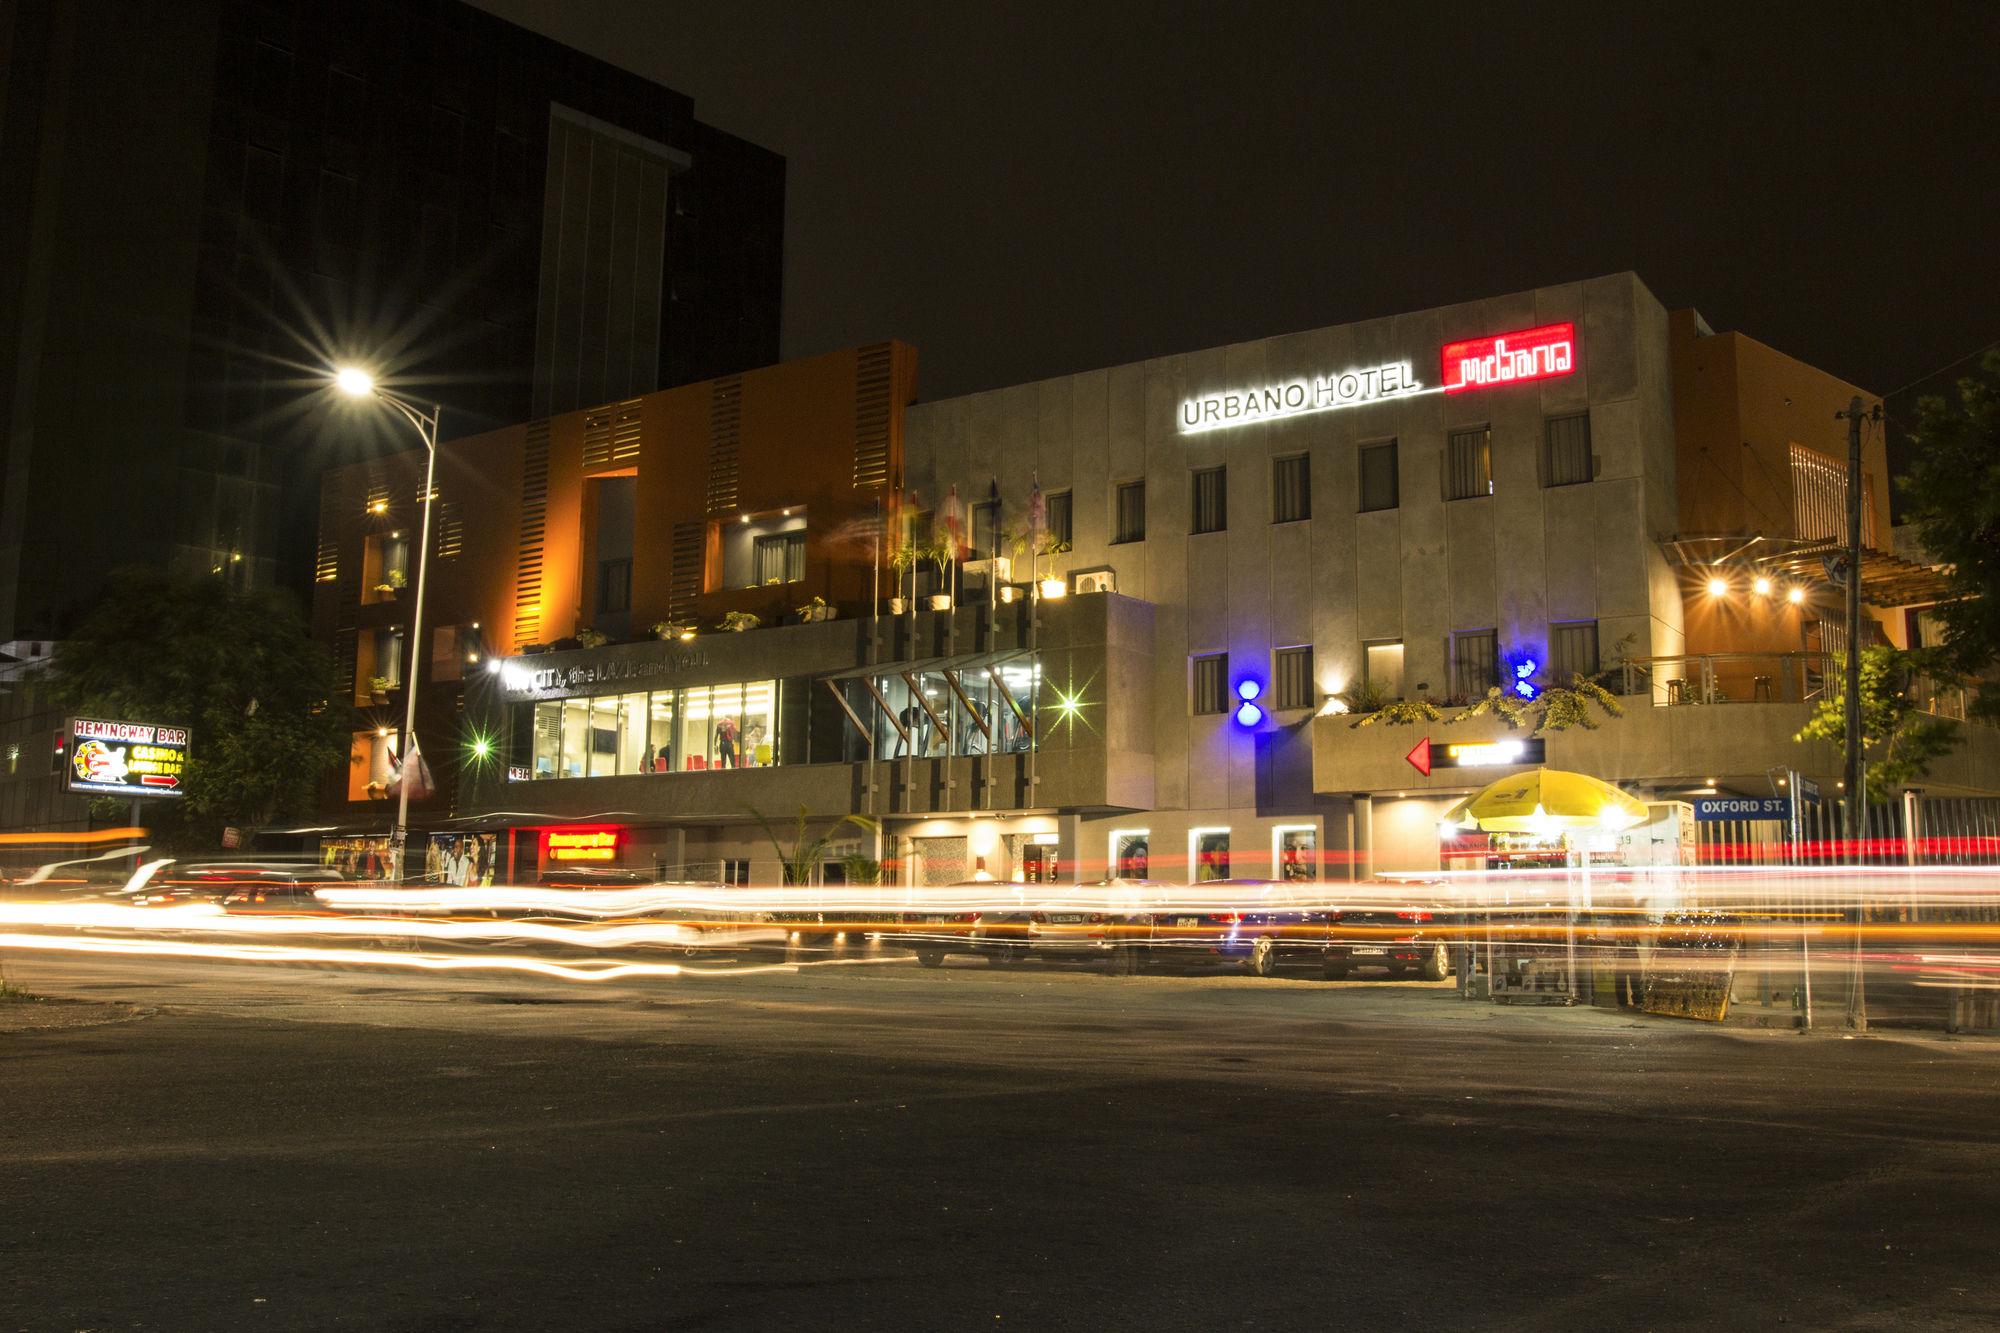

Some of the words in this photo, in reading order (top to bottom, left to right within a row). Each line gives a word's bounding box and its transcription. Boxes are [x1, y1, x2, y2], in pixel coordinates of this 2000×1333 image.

[1183, 384, 1305, 426] URBANO
[1315, 364, 1416, 405] HOTEL
[568, 664, 595, 684] the
[75, 720, 155, 743] HEMINGWAY
[157, 729, 187, 745] BAR
[132, 746, 177, 762] CASINO
[1701, 801, 1760, 814] OXFORD
[1762, 800, 1785, 812] ST.
